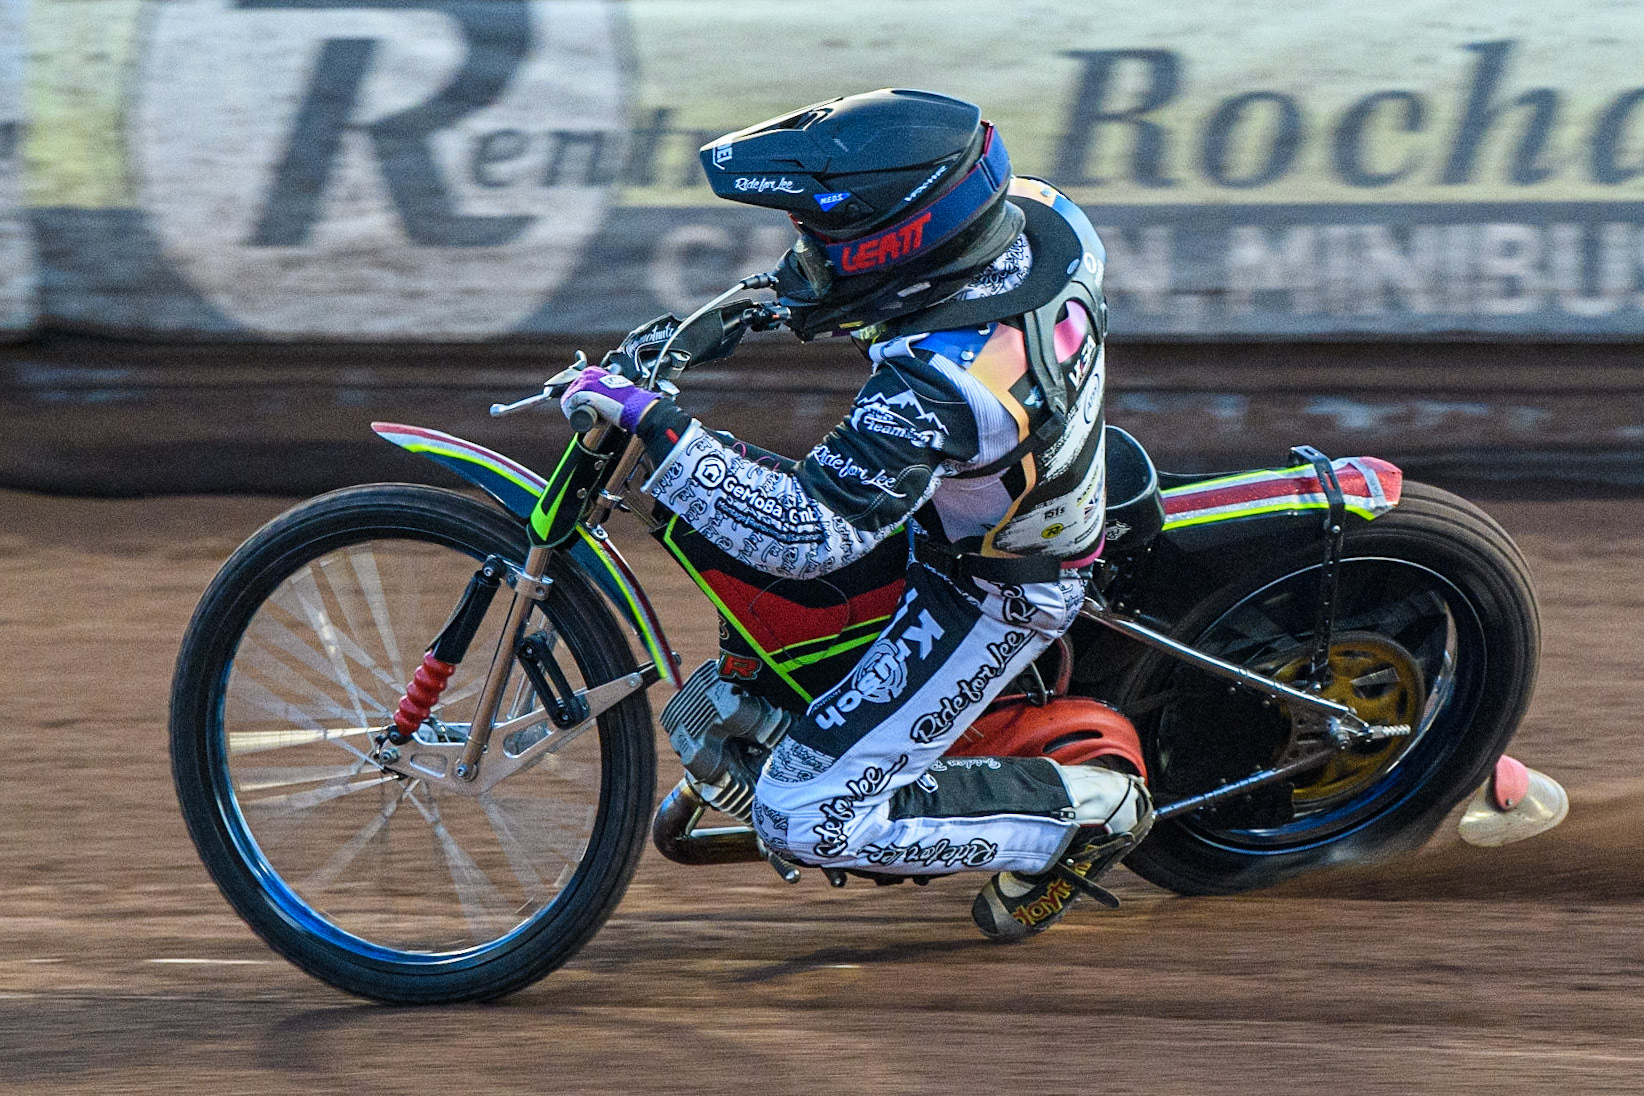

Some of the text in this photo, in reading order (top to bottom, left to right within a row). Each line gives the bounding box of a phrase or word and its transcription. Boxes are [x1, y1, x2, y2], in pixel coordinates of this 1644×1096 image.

[735, 177, 804, 193] Ride for Lee
[840, 211, 932, 273] LEATT
[1226, 222, 1644, 318] MINIBU
[723, 476, 784, 518] GeMoBa
[810, 444, 907, 498] Ride for Lee
[815, 607, 945, 730] Krusch
[910, 628, 1038, 743] Ride for Lee
[819, 796, 855, 821] fo
[846, 754, 909, 801] Lee
[903, 838, 950, 867] for
[940, 837, 998, 868] Ride
